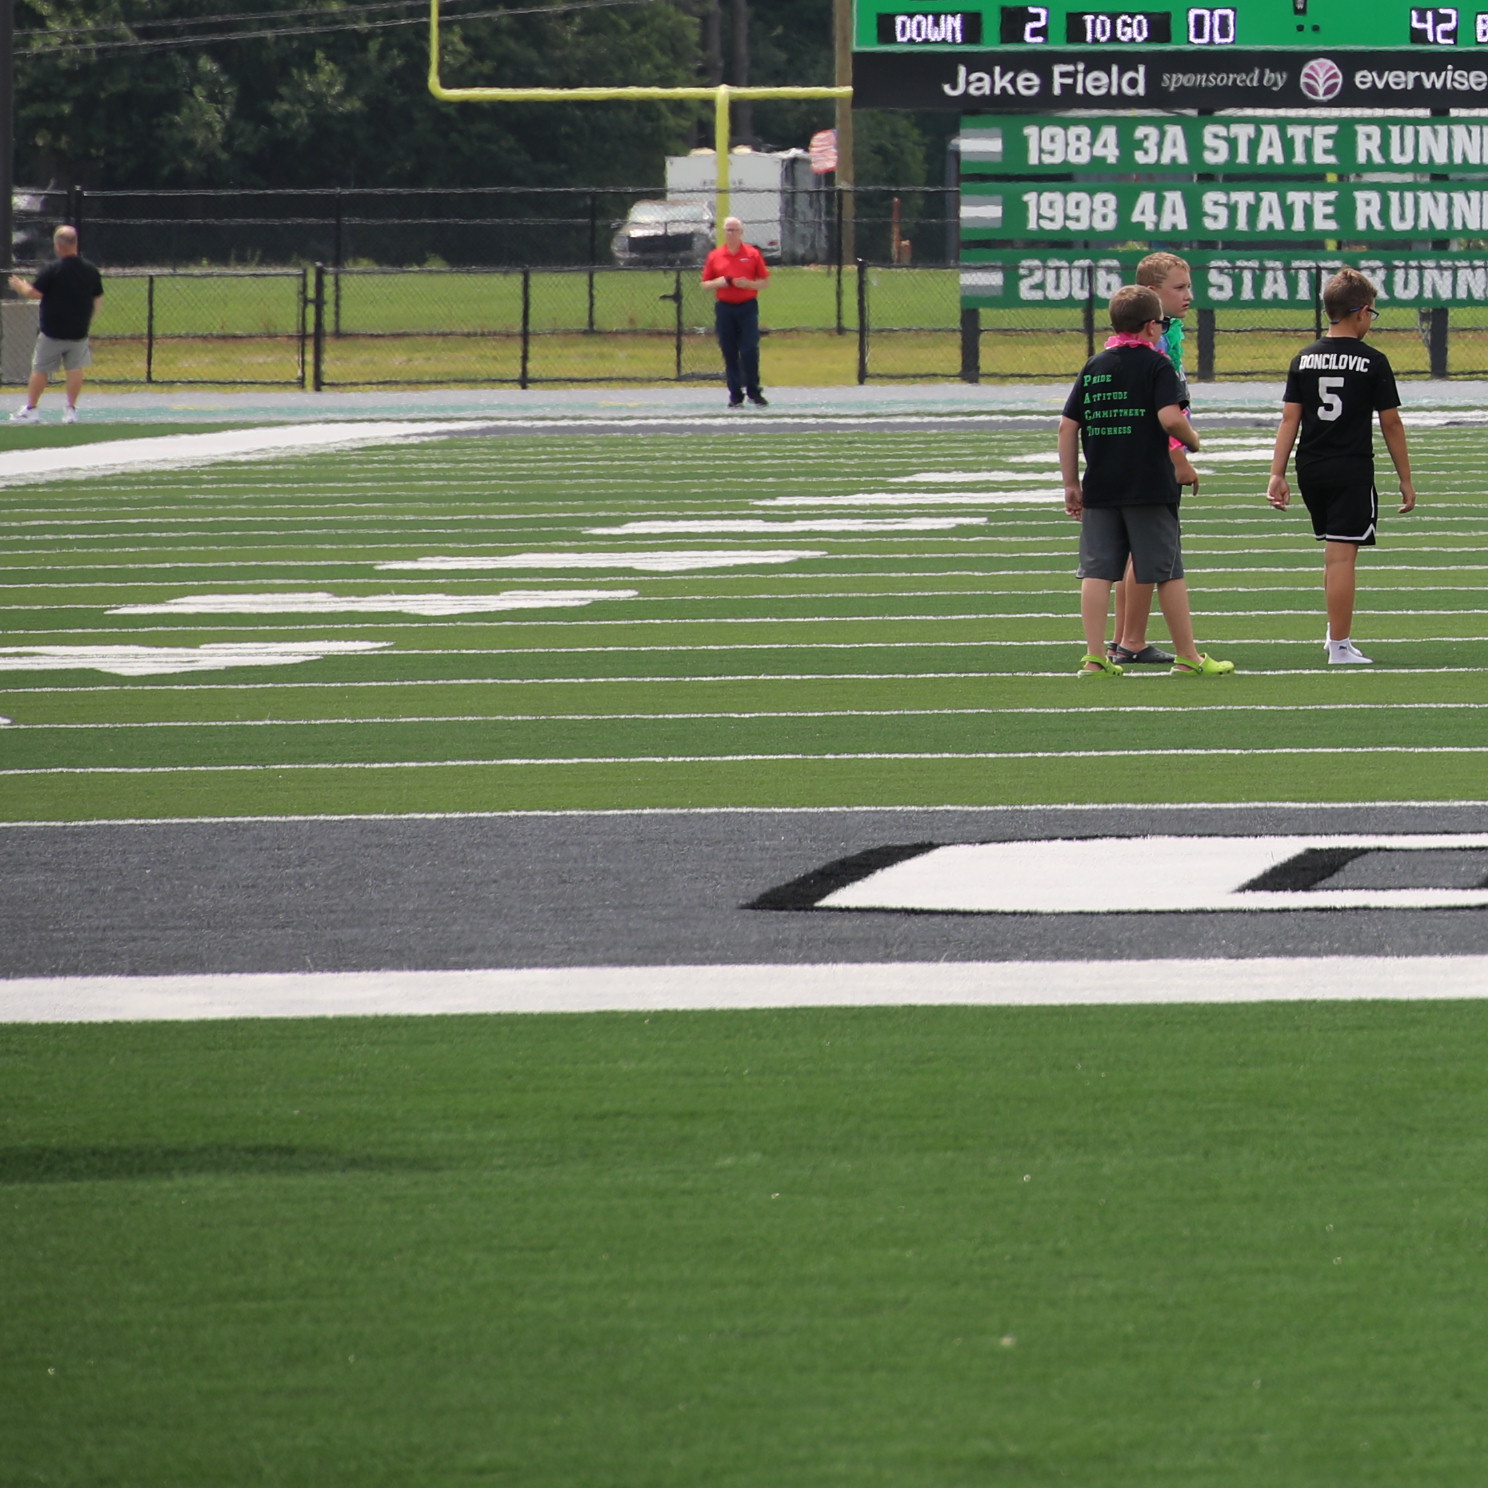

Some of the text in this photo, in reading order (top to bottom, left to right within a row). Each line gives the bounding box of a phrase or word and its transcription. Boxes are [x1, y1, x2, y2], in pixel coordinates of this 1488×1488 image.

[894, 14, 963, 43] DOWN
[1023, 6, 1048, 43] 2
[1082, 14, 1149, 43] TO GO
[1187, 7, 1236, 44] 00
[1410, 8, 1458, 45] 42
[942, 64, 1040, 97] Jake
[1052, 63, 1145, 96] Field
[1161, 66, 1258, 91] sponsored
[1263, 66, 1287, 92] by
[1354, 65, 1488, 91] everwise
[1022, 124, 1120, 165] 1984
[1133, 124, 1189, 165] 3A
[1202, 123, 1339, 165] STATE
[1022, 190, 1118, 231] 1998
[1130, 190, 1189, 231] 4A
[1202, 189, 1339, 231] STATE
[1018, 258, 1122, 301] 2006
[1299, 353, 1371, 373] DONCILOVIC
[1317, 376, 1345, 422] 5
